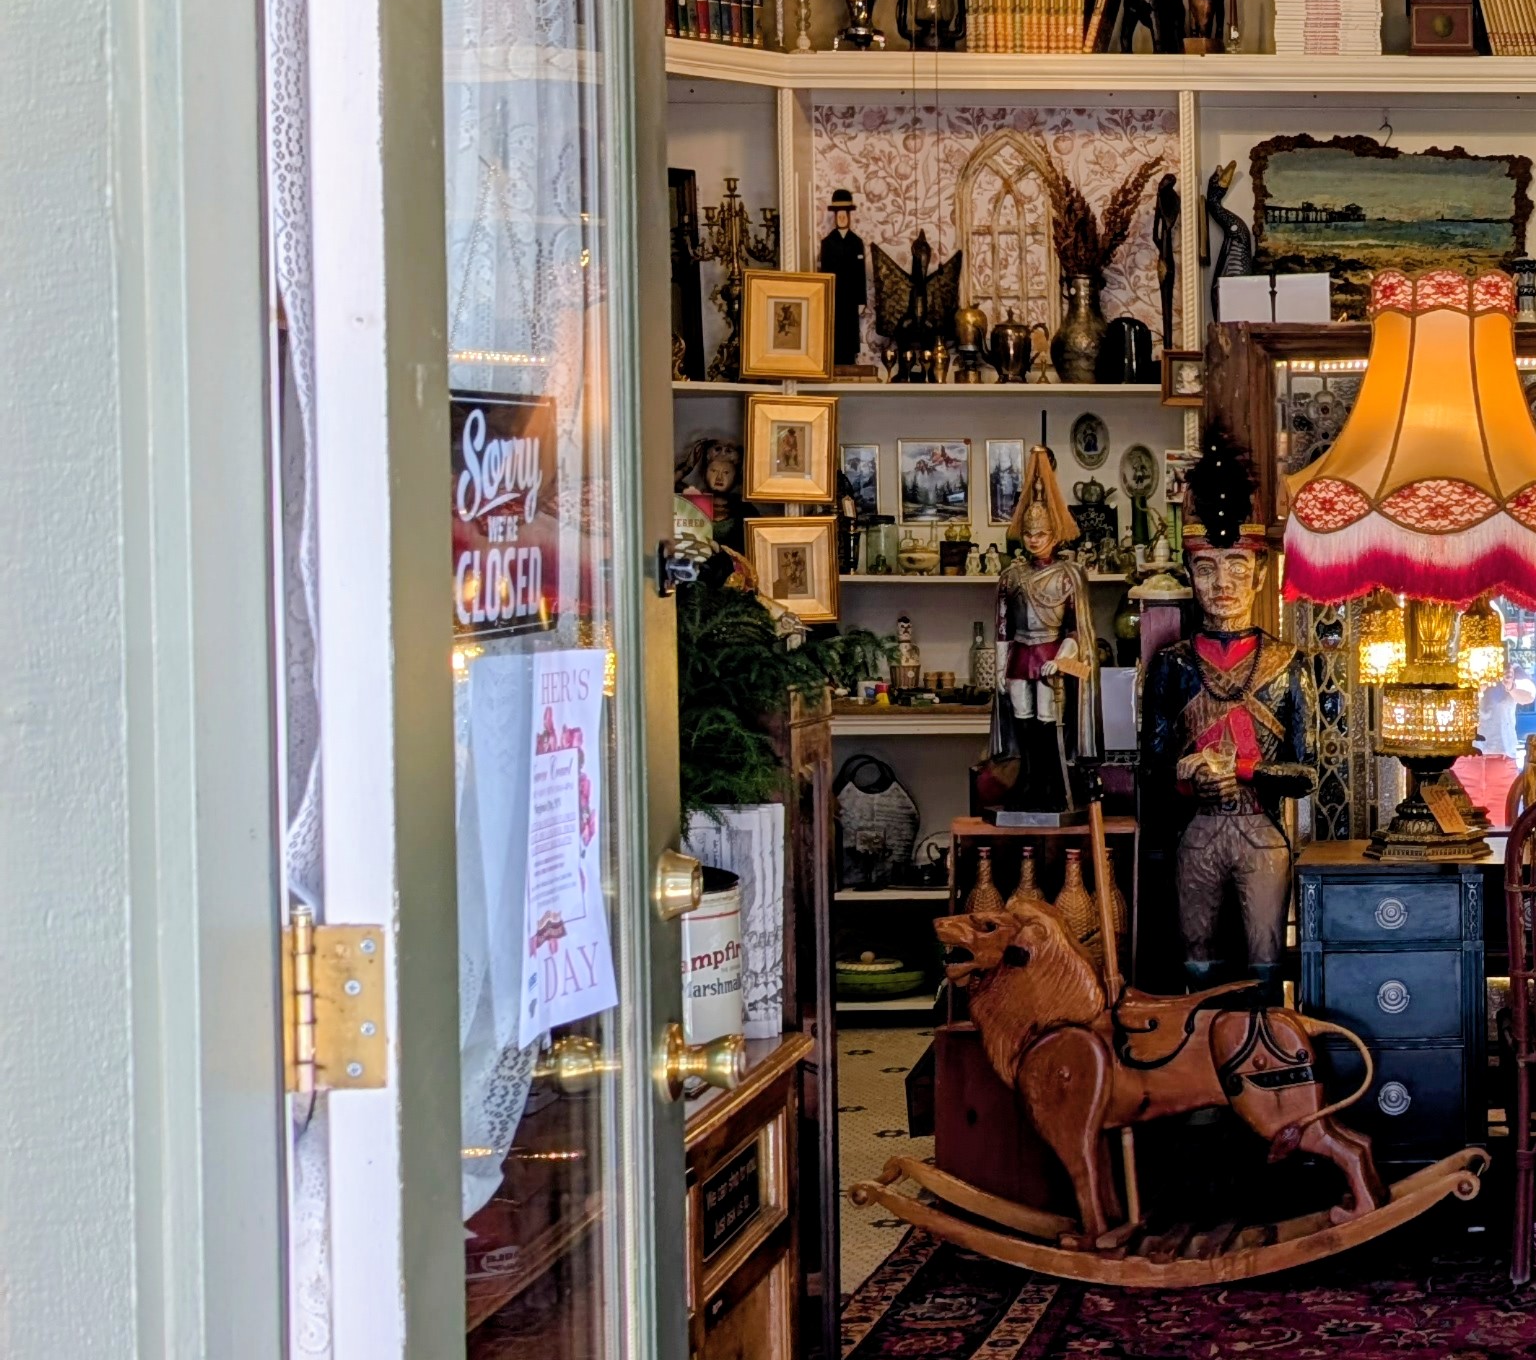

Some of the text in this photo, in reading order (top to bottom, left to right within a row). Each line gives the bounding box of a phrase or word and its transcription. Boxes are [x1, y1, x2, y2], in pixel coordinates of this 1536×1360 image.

[457, 408, 543, 524] Sorry
[488, 515, 519, 543] WE'RE
[456, 546, 542, 625] CLOSED
[544, 941, 599, 1004] DAY
